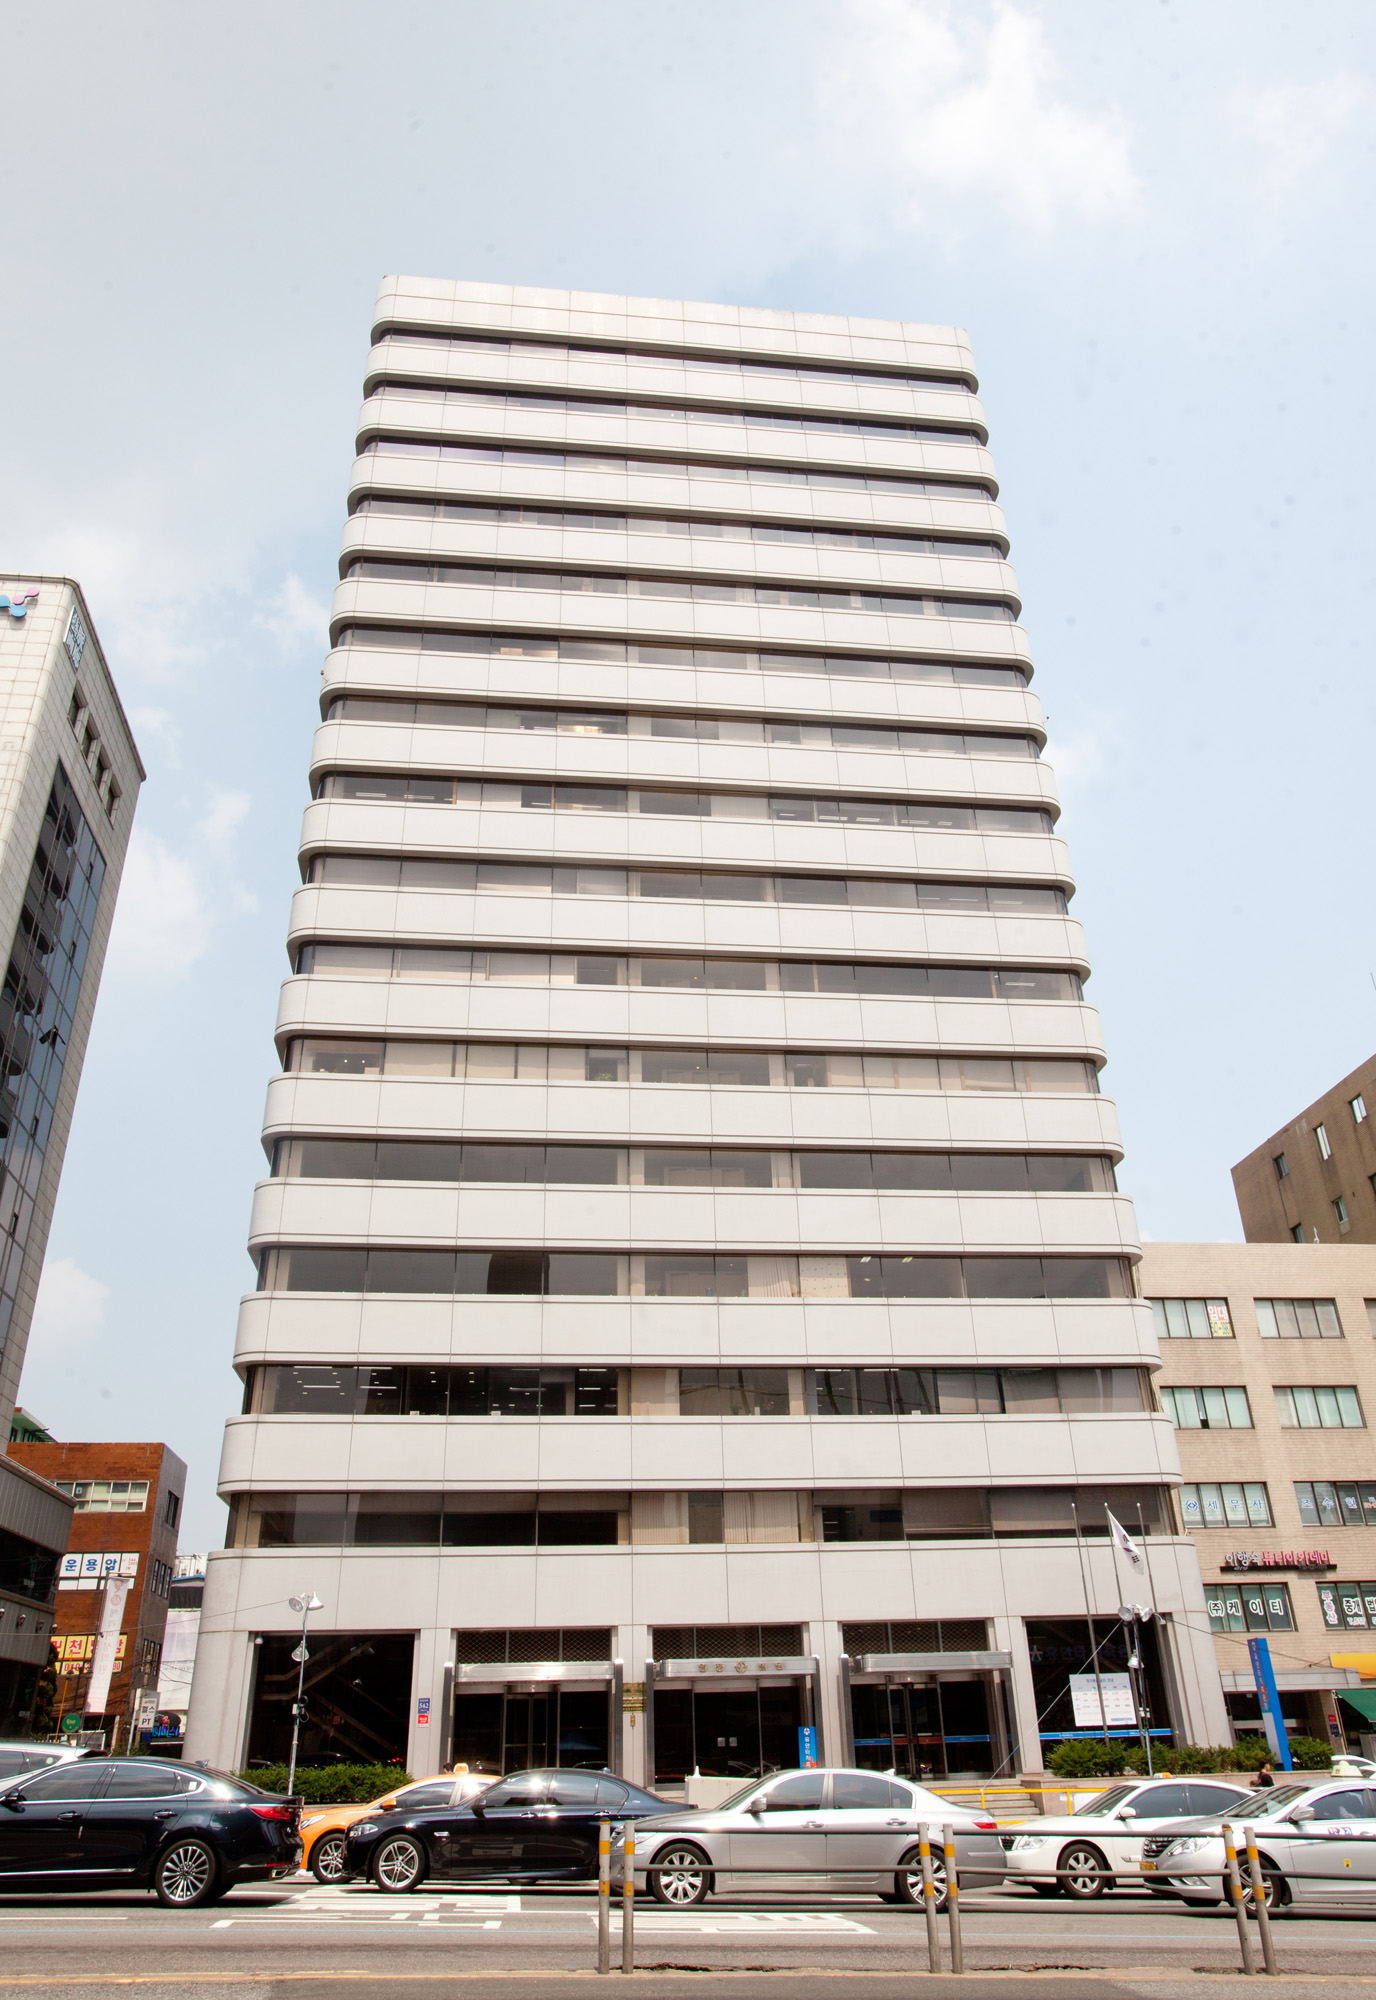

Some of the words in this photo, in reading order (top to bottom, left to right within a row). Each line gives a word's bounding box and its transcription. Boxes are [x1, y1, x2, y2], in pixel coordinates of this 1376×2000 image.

[1207, 1305, 1230, 1320] 임대
[1208, 1500, 1263, 1510] 세무사
[65, 1558, 118, 1572] 운용암
